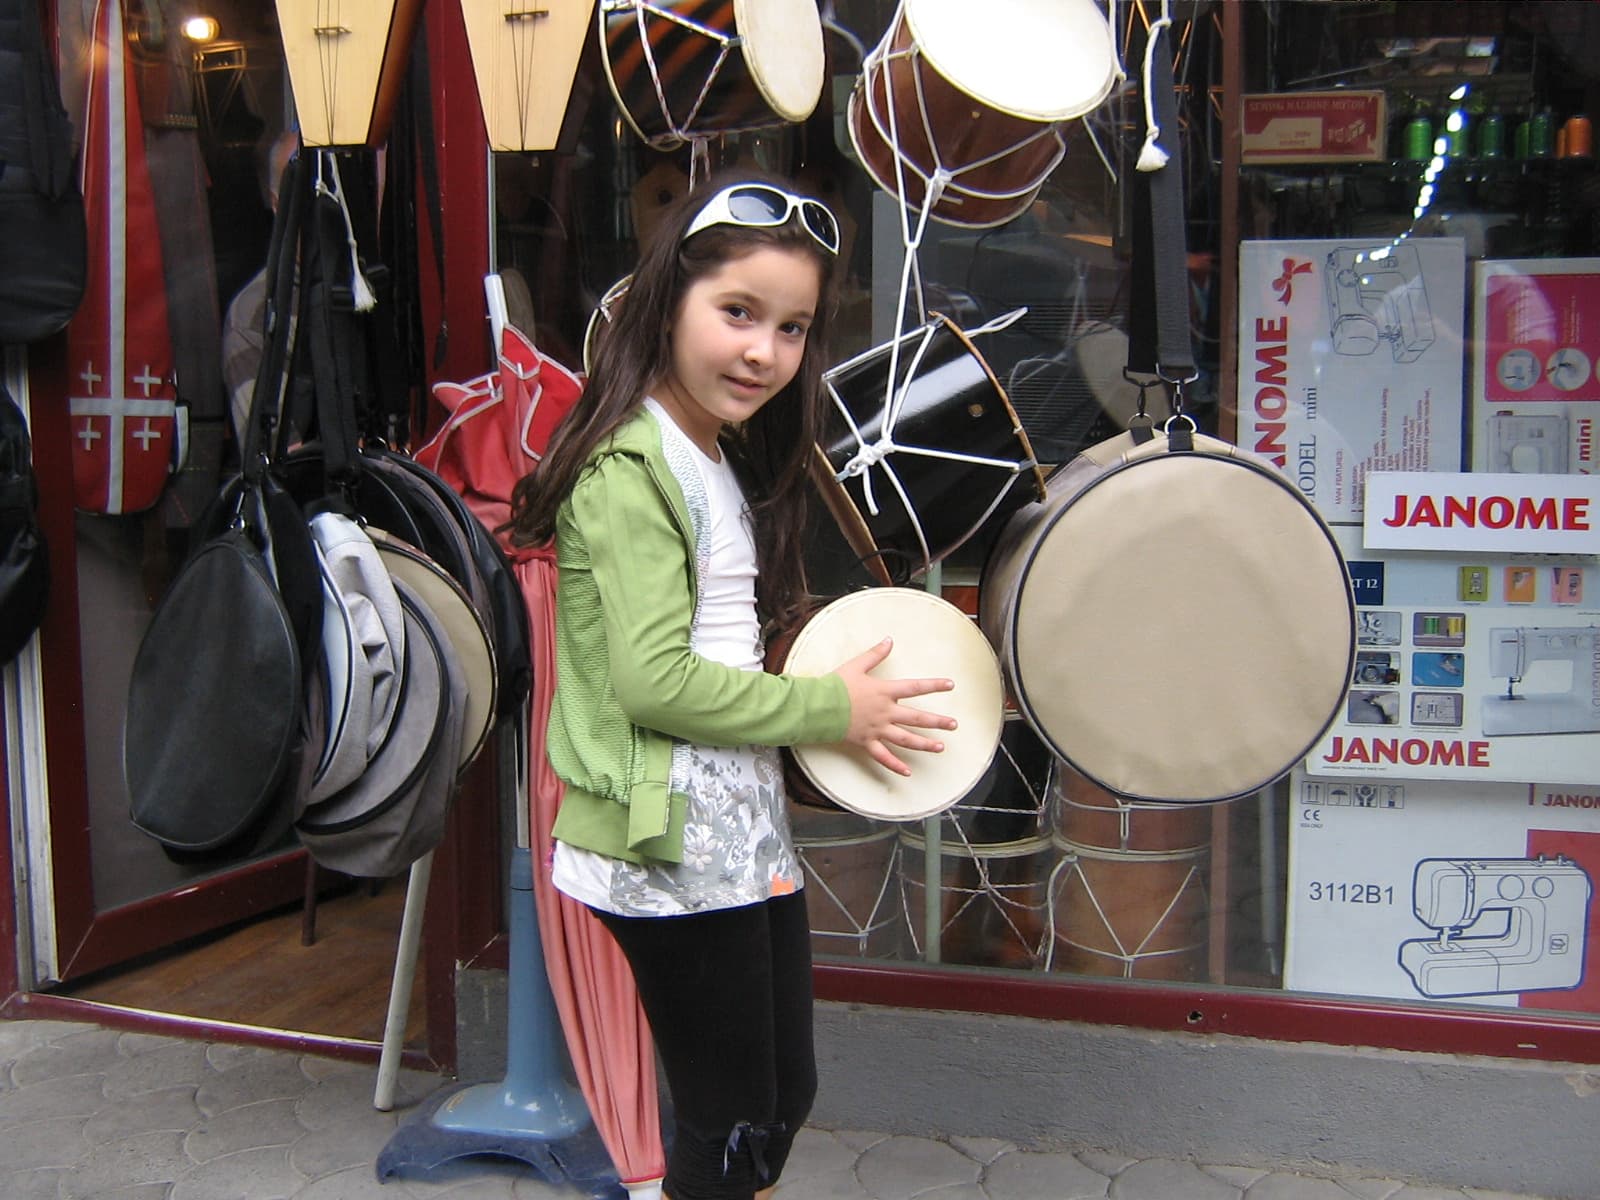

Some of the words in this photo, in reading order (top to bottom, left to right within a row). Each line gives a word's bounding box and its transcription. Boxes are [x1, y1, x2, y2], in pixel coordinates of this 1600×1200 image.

[1302, 387, 1317, 420] mini
[1576, 419, 1592, 462] mini
[1383, 494, 1590, 530] JANOME
[1366, 578, 1378, 589] 12
[1323, 736, 1491, 768] JANOME
[1309, 881, 1394, 905] 3112B1
